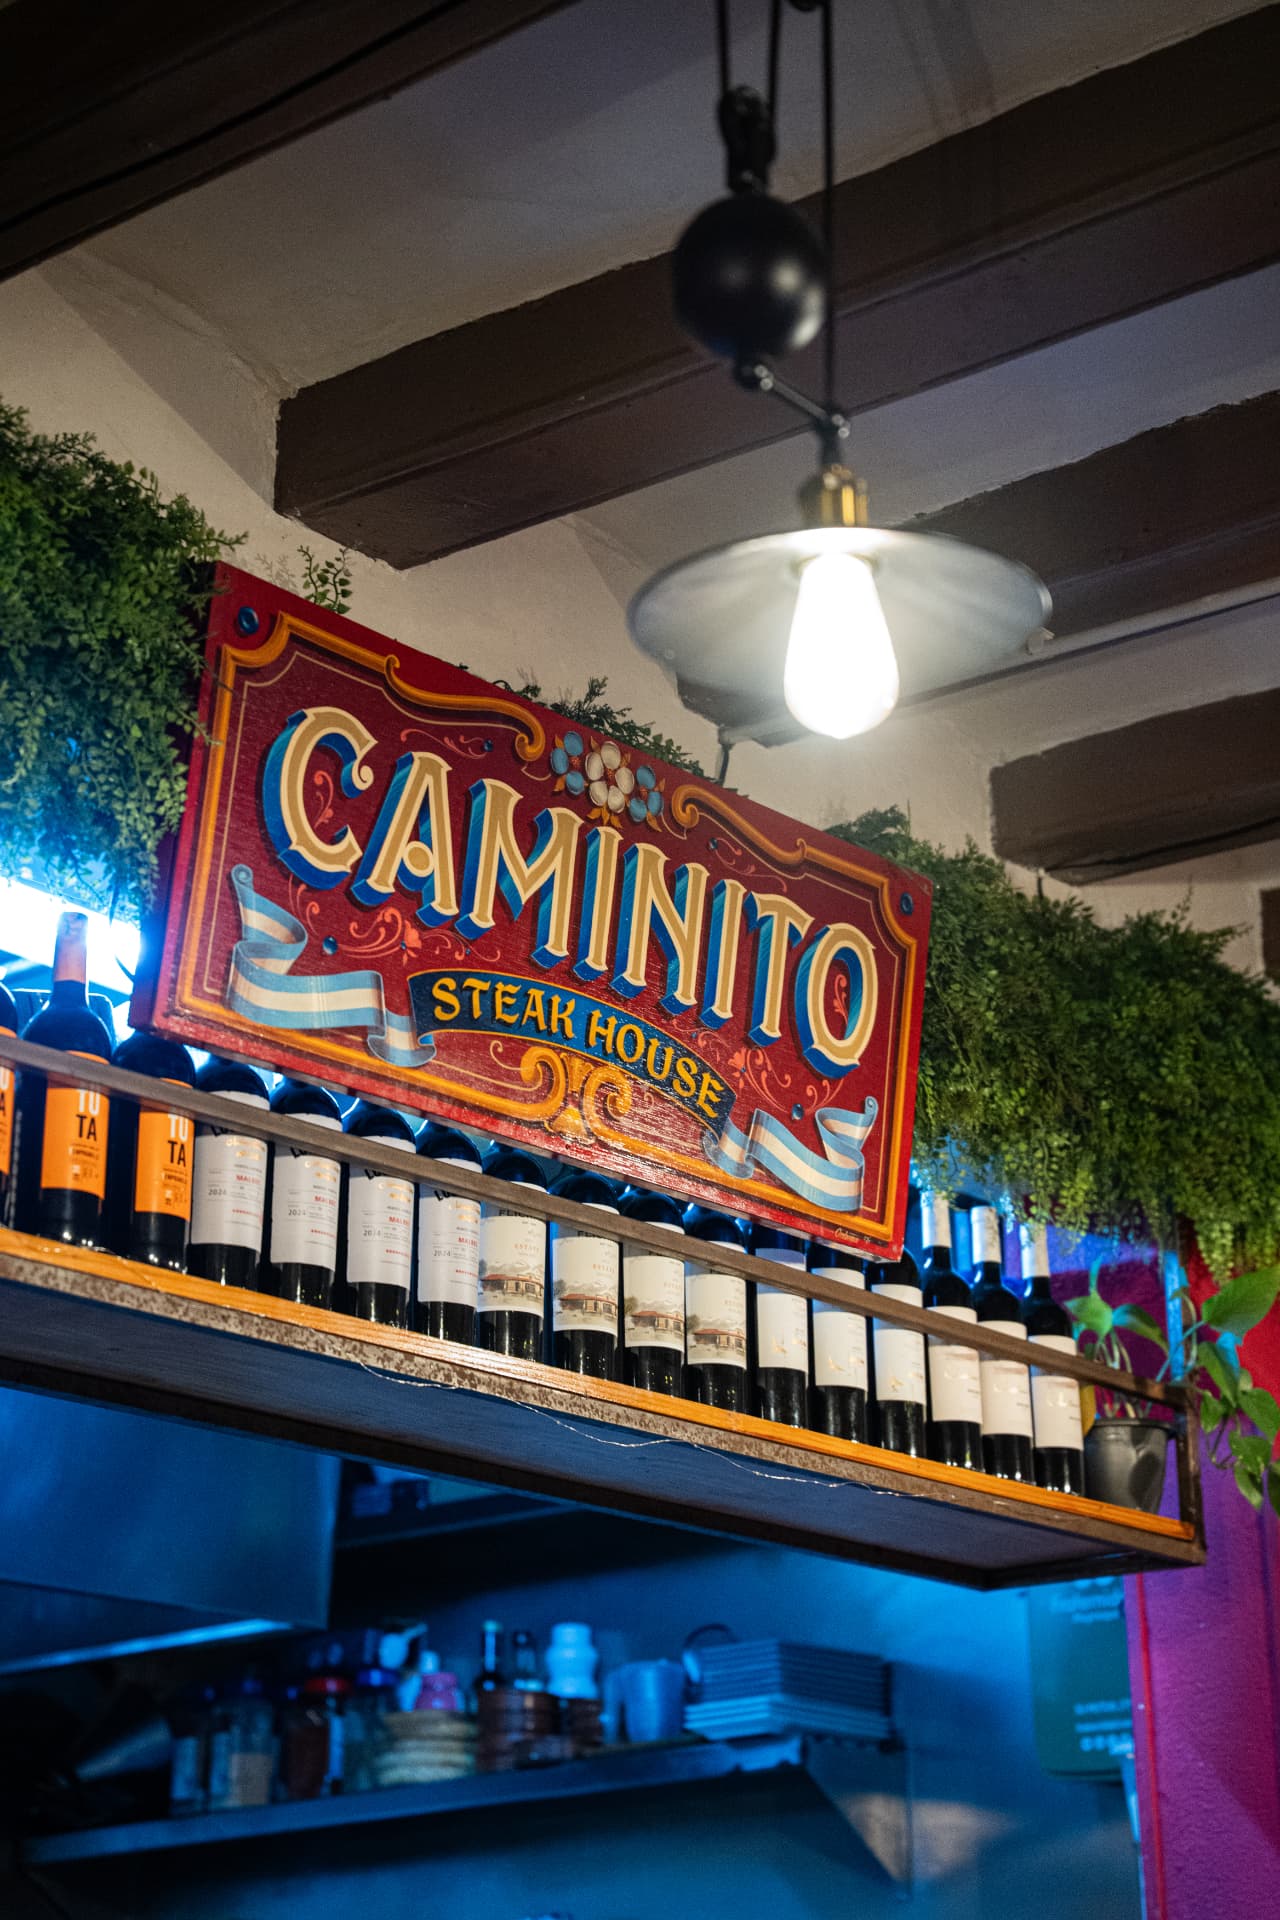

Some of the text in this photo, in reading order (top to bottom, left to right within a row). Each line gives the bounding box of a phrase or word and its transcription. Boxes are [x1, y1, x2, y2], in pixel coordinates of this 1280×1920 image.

[263, 706, 879, 1078] CAMINITO
[431, 977, 724, 1118] STEAK HOUSE
[76, 1087, 100, 1116] TU
[76, 1114, 97, 1142] TA
[167, 1110, 189, 1142] TU
[168, 1140, 186, 1167] TA
